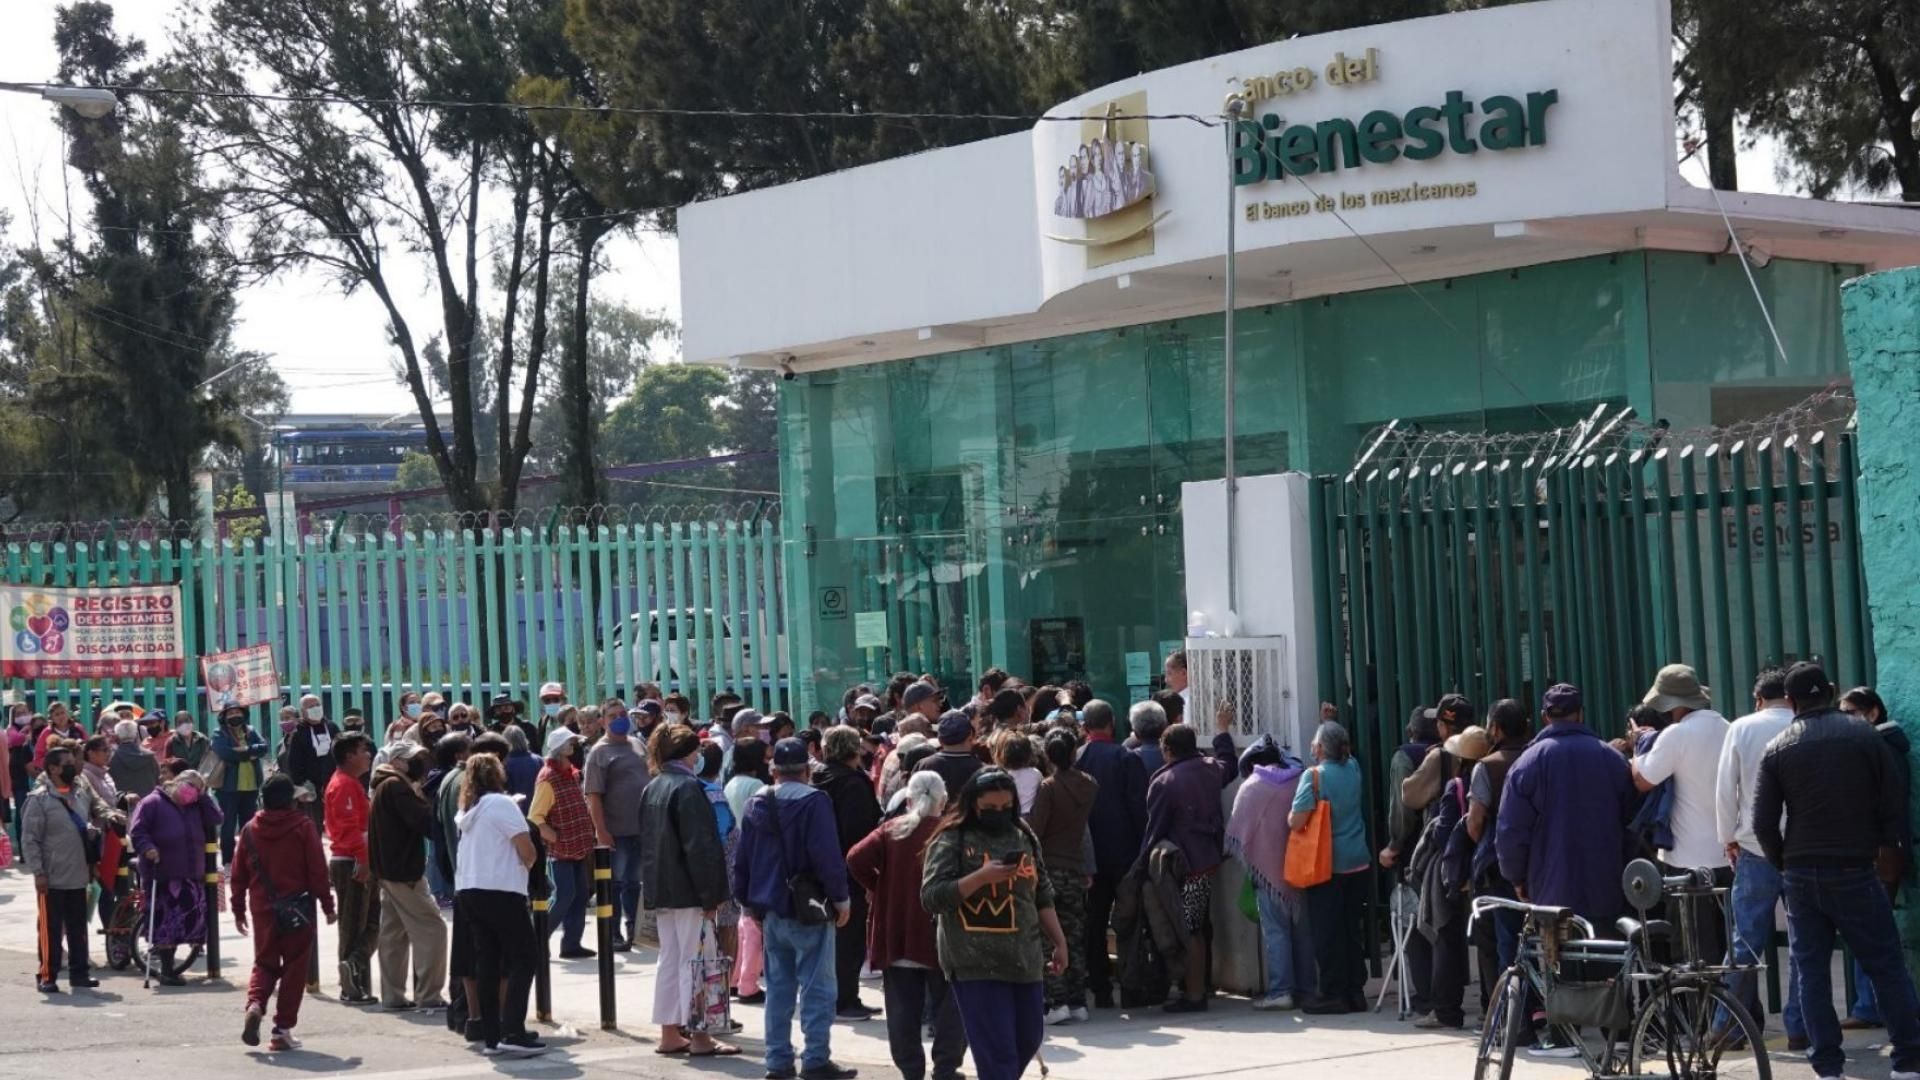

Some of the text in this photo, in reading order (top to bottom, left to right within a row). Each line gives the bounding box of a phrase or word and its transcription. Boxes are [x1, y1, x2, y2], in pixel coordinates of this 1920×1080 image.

[1324, 47, 1378, 86] del
[1225, 89, 1559, 186] Bienestar
[1246, 181, 1477, 221] El banco de los mexicanos
[74, 594, 173, 611] REGISTRO
[77, 612, 173, 625] DE SOLICITANTES
[76, 643, 175, 655] DISCAPACIDAD
